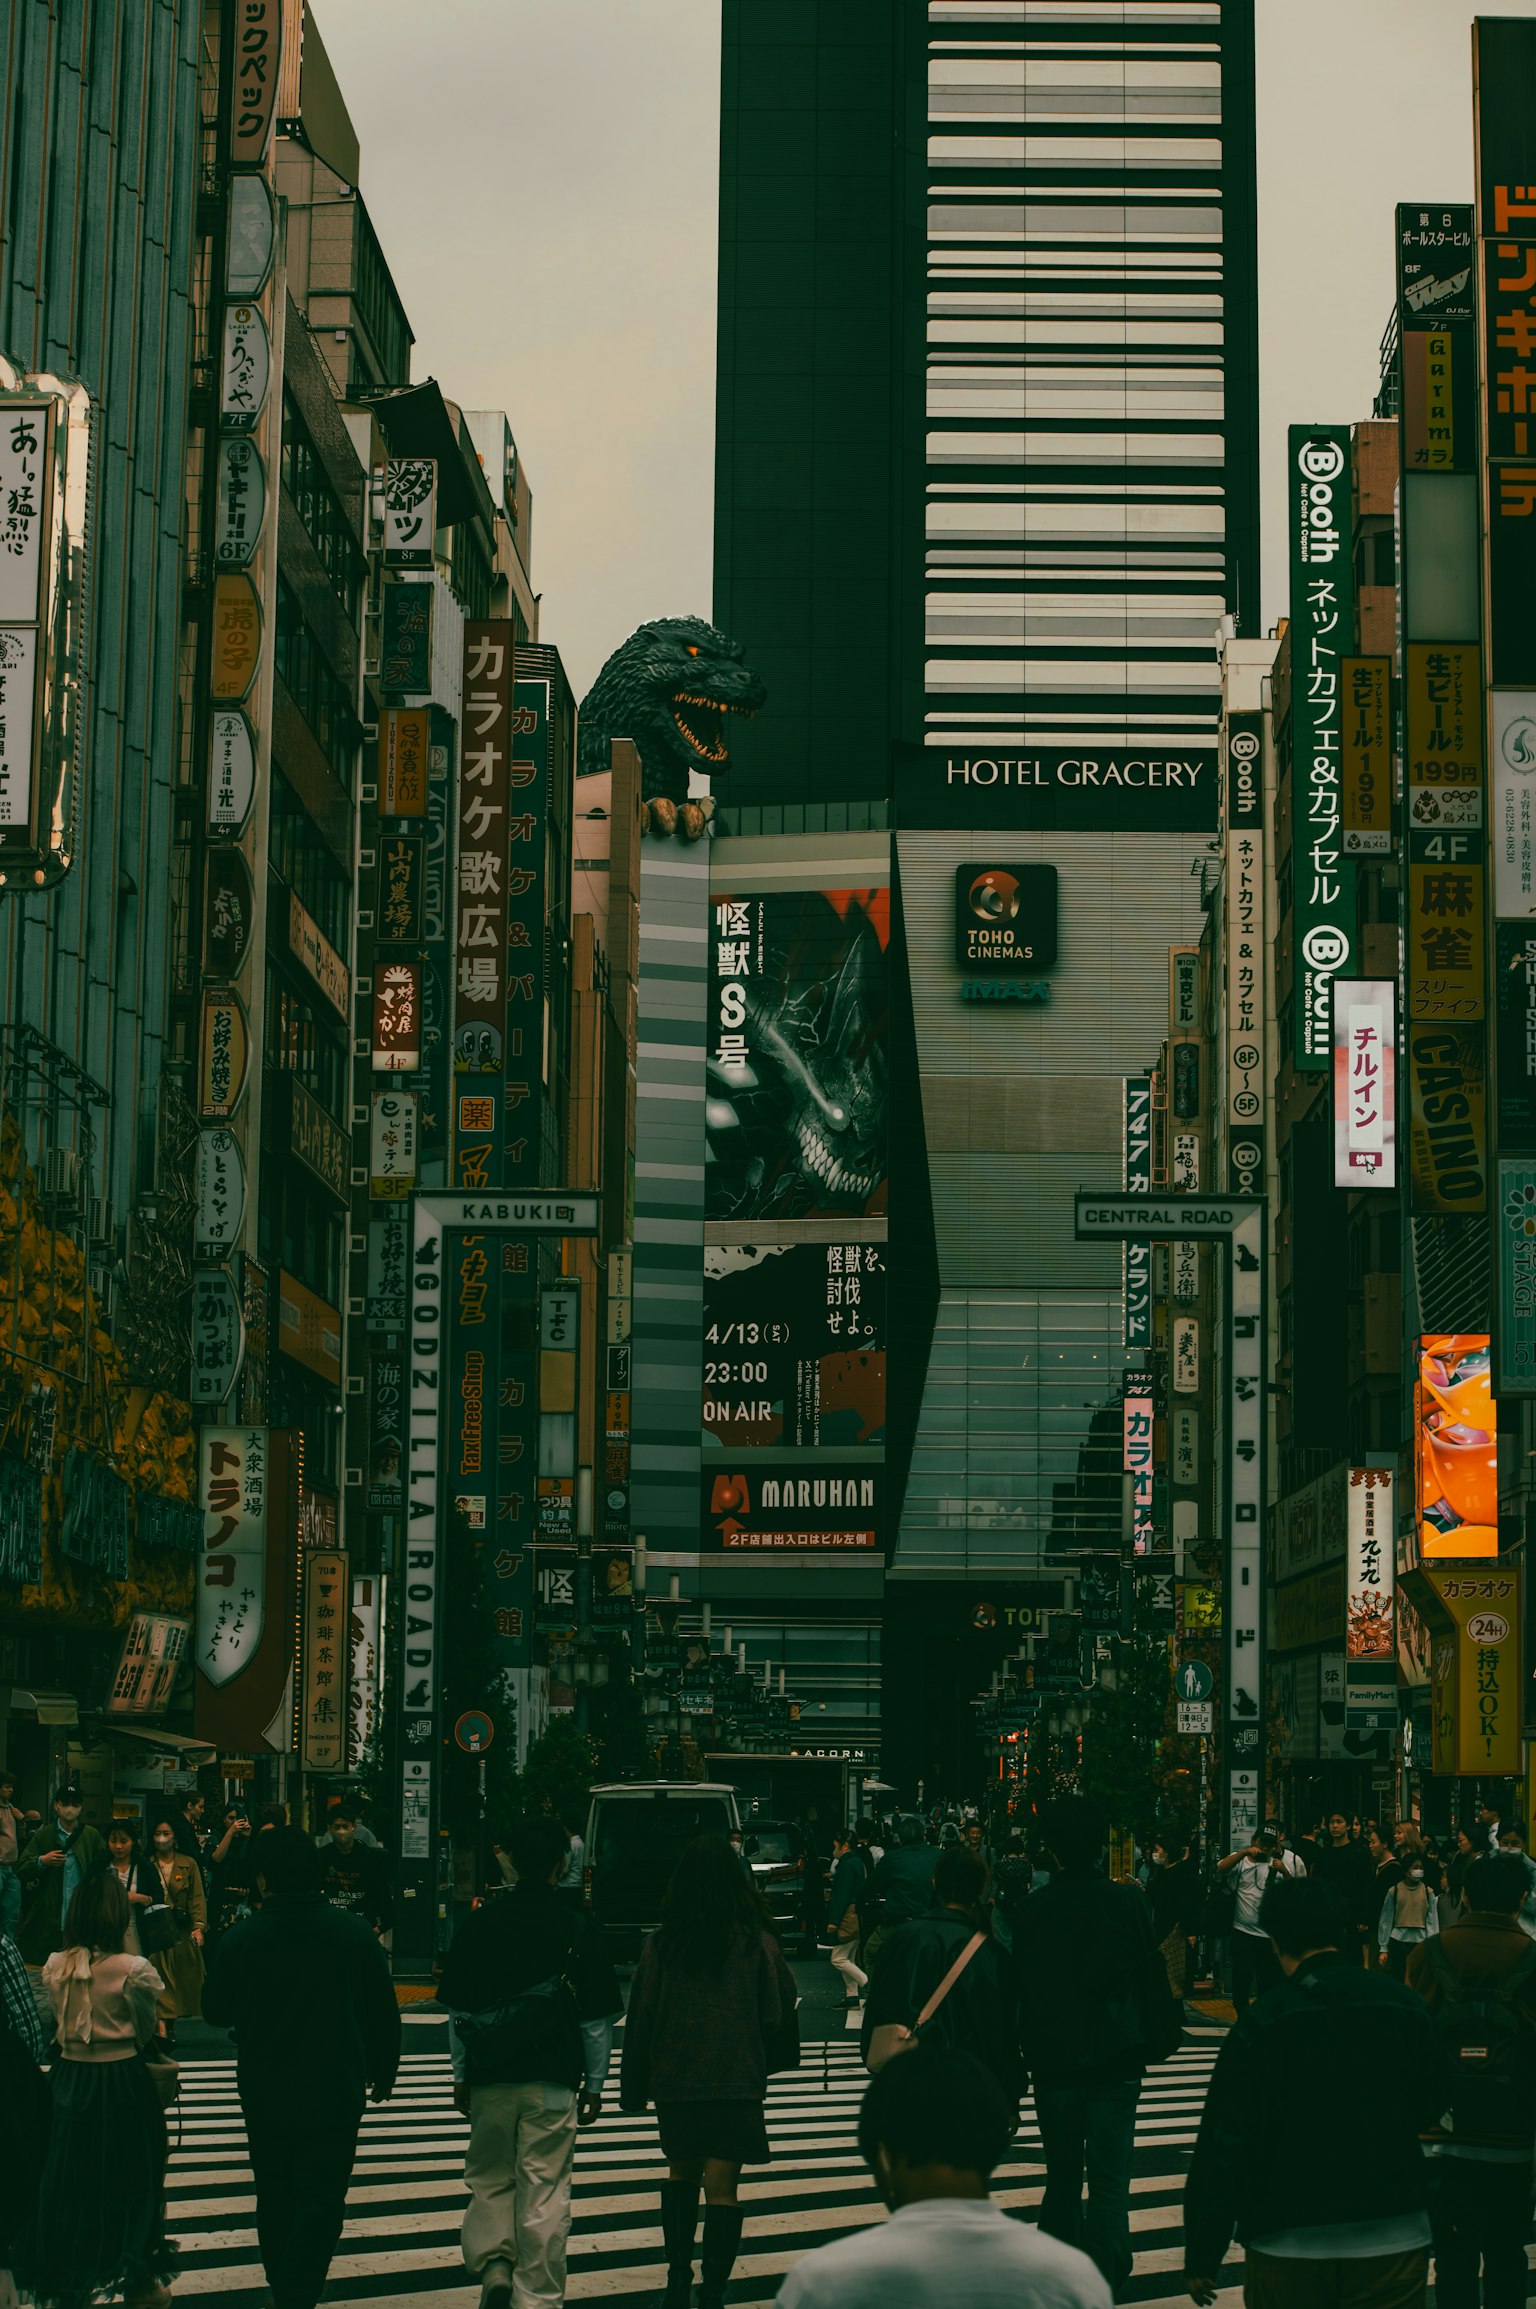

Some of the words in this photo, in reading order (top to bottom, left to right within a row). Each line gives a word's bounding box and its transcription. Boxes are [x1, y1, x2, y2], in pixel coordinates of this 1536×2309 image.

[1405, 265, 1421, 273] 8F
[1430, 321, 1447, 331] 7F
[228, 337, 254, 408] うさぎや
[1428, 339, 1452, 441] Garam
[229, 413, 247, 425] 7F
[1414, 449, 1455, 464] ガラ
[228, 463, 249, 530] ヤキトリ
[392, 462, 425, 543] ダーツ
[1298, 440, 1344, 563] Booth
[1300, 483, 1309, 497] Net
[1300, 498, 1309, 520] Cafe
[219, 542, 250, 559] 6F
[401, 549, 416, 560] 8F
[1300, 529, 1309, 563] Capsule
[220, 608, 254, 671] 虎の子
[384, 601, 429, 686] 海の家
[1352, 668, 1374, 748] 生ビール
[1426, 653, 1452, 752] 生ビール
[1453, 654, 1464, 751] ザ・プレミアム・モルツ
[399, 723, 421, 801] 鳥貴族
[946, 760, 1050, 786] HOTEL
[1056, 759, 1205, 788] GRACERY
[1230, 731, 1260, 813] Booth
[1413, 760, 1478, 783] 199円
[218, 788, 235, 807] 光
[1358, 752, 1375, 824] 199円
[218, 824, 231, 835] 4F
[457, 635, 504, 1003] カラオケ歌広場
[1442, 811, 1478, 824] 鳥メロ
[1505, 788, 1516, 864] 03-6228-0830
[1362, 840, 1388, 849] 鳥メロ
[1424, 835, 1469, 862] 4F
[1520, 788, 1533, 894] 美容外科・美容皮膚科
[384, 840, 414, 927] 山内農場
[1238, 839, 1254, 935] ネットカフェ
[212, 887, 234, 940] カラオケ
[757, 901, 765, 932] KAIJU
[1419, 871, 1475, 972] 麻雀
[392, 927, 406, 937] 5F
[967, 929, 1015, 944] TOHO
[967, 946, 1034, 959] CINEMAS
[1239, 943, 1254, 959] &
[714, 901, 752, 1070] 怪獣8号
[1304, 971, 1313, 986] Net
[1415, 979, 1464, 995] スリー
[396, 982, 417, 1034] 焼肉屋
[1179, 967, 1194, 1022] 東京ビル
[1238, 966, 1254, 1032] カプセル
[1304, 987, 1313, 1010] Cafe
[1415, 999, 1481, 1016] ファイブ
[376, 987, 397, 1047] さかい
[1304, 1019, 1313, 1055] Capsule
[211, 1009, 232, 1104] お好み焼き
[384, 1053, 407, 1070] 4F
[1236, 1051, 1255, 1065] 8F
[1353, 1026, 1379, 1129] チルイン
[203, 1105, 229, 1116] 2階
[463, 1100, 491, 1128] 薬
[1238, 1097, 1255, 1110] 5F
[1412, 1033, 1484, 1202] CASINO
[209, 1155, 229, 1238] とらそば
[382, 1179, 407, 1195] 3F
[1085, 1209, 1175, 1224] CENTRAL
[1181, 1210, 1233, 1224] ROAD
[203, 1243, 224, 1257] 1F
[378, 1222, 406, 1297] お好み焼
[826, 1245, 887, 1275] 怪獣を、
[198, 1281, 227, 1294] 新宿
[826, 1277, 861, 1306] 討伐
[1512, 1240, 1532, 1319] STAGE
[197, 1294, 227, 1370] かっぱ
[825, 1308, 877, 1336] せよ。
[616, 1348, 628, 1381] ダーツ
[704, 1361, 768, 1384] 23:00
[1126, 1373, 1153, 1382] カラオケ
[199, 1378, 222, 1393] B1
[408, 1273, 440, 1521] GODZILLA
[1127, 1385, 1152, 1395] 747
[702, 1400, 730, 1422] ON
[734, 1400, 772, 1422] AIR
[243, 1432, 265, 1517] 大衆酒場
[1234, 1314, 1260, 1649] ゴジラロード
[541, 1496, 573, 1508] つり具
[761, 1479, 875, 1508] MARUHAN
[204, 1441, 241, 1588] トラノコ
[605, 1523, 628, 1531] more
[1359, 1539, 1382, 1585] 九十九
[537, 1568, 576, 1605] 怪
[1442, 1579, 1515, 1599] カラオケ
[229, 1587, 256, 1649] やきとり
[407, 1550, 433, 1668] ROAD
[205, 1599, 234, 1662] やきとん
[1474, 1618, 1503, 1637] 24H
[316, 1604, 335, 1688] 珈琲茶館
[311, 1696, 338, 1724] 集
[1349, 1691, 1395, 1701] FamilyMart
[1365, 1714, 1379, 1728] 酒
[316, 1748, 330, 1756] 2F
[804, 1749, 864, 1758] ACORN
